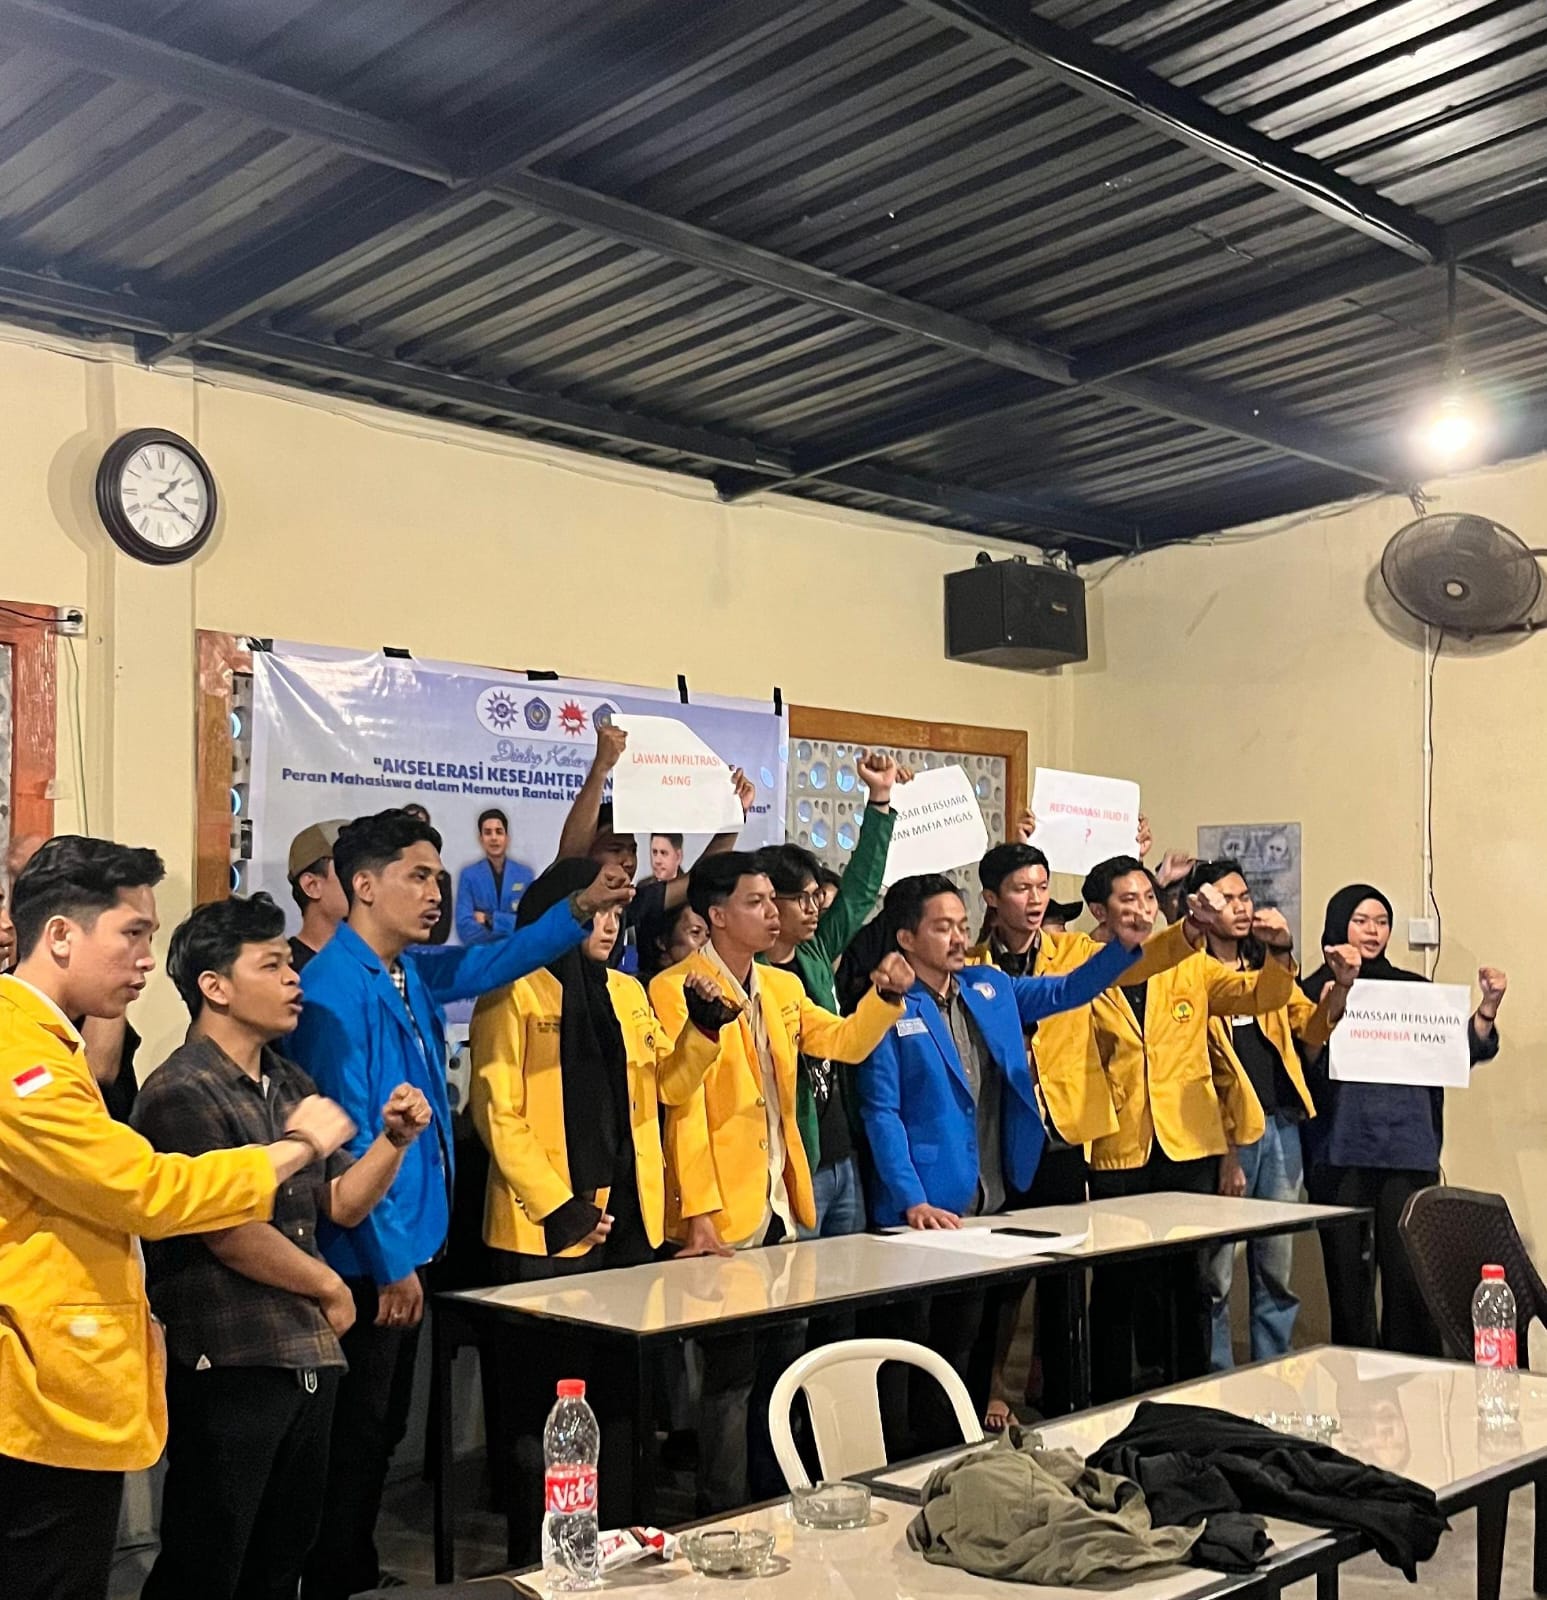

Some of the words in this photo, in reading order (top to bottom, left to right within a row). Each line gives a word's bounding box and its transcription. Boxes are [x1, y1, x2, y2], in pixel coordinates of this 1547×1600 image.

[632, 752, 668, 765] LAWAN
[671, 753, 720, 767] INFILTRASI
[282, 767, 327, 783] Peran
[331, 771, 412, 789] Mahasiswa
[415, 778, 460, 793] dalam
[462, 781, 520, 798] Memutus
[522, 786, 564, 801] Rantai
[488, 766, 613, 790] KESEJAHTERN
[661, 775, 691, 786] ASING
[921, 794, 968, 815] BERSUARA
[1049, 802, 1101, 818] REFORMASI
[912, 819, 942, 836] MAFIA
[944, 811, 973, 826] MIGAS
[1084, 828, 1092, 844] ?
[1401, 1012, 1461, 1025] BERSUARA
[1350, 1029, 1411, 1041] INDONESIA
[1413, 1032, 1446, 1044] EMAS
[553, 1477, 590, 1510] Vit
